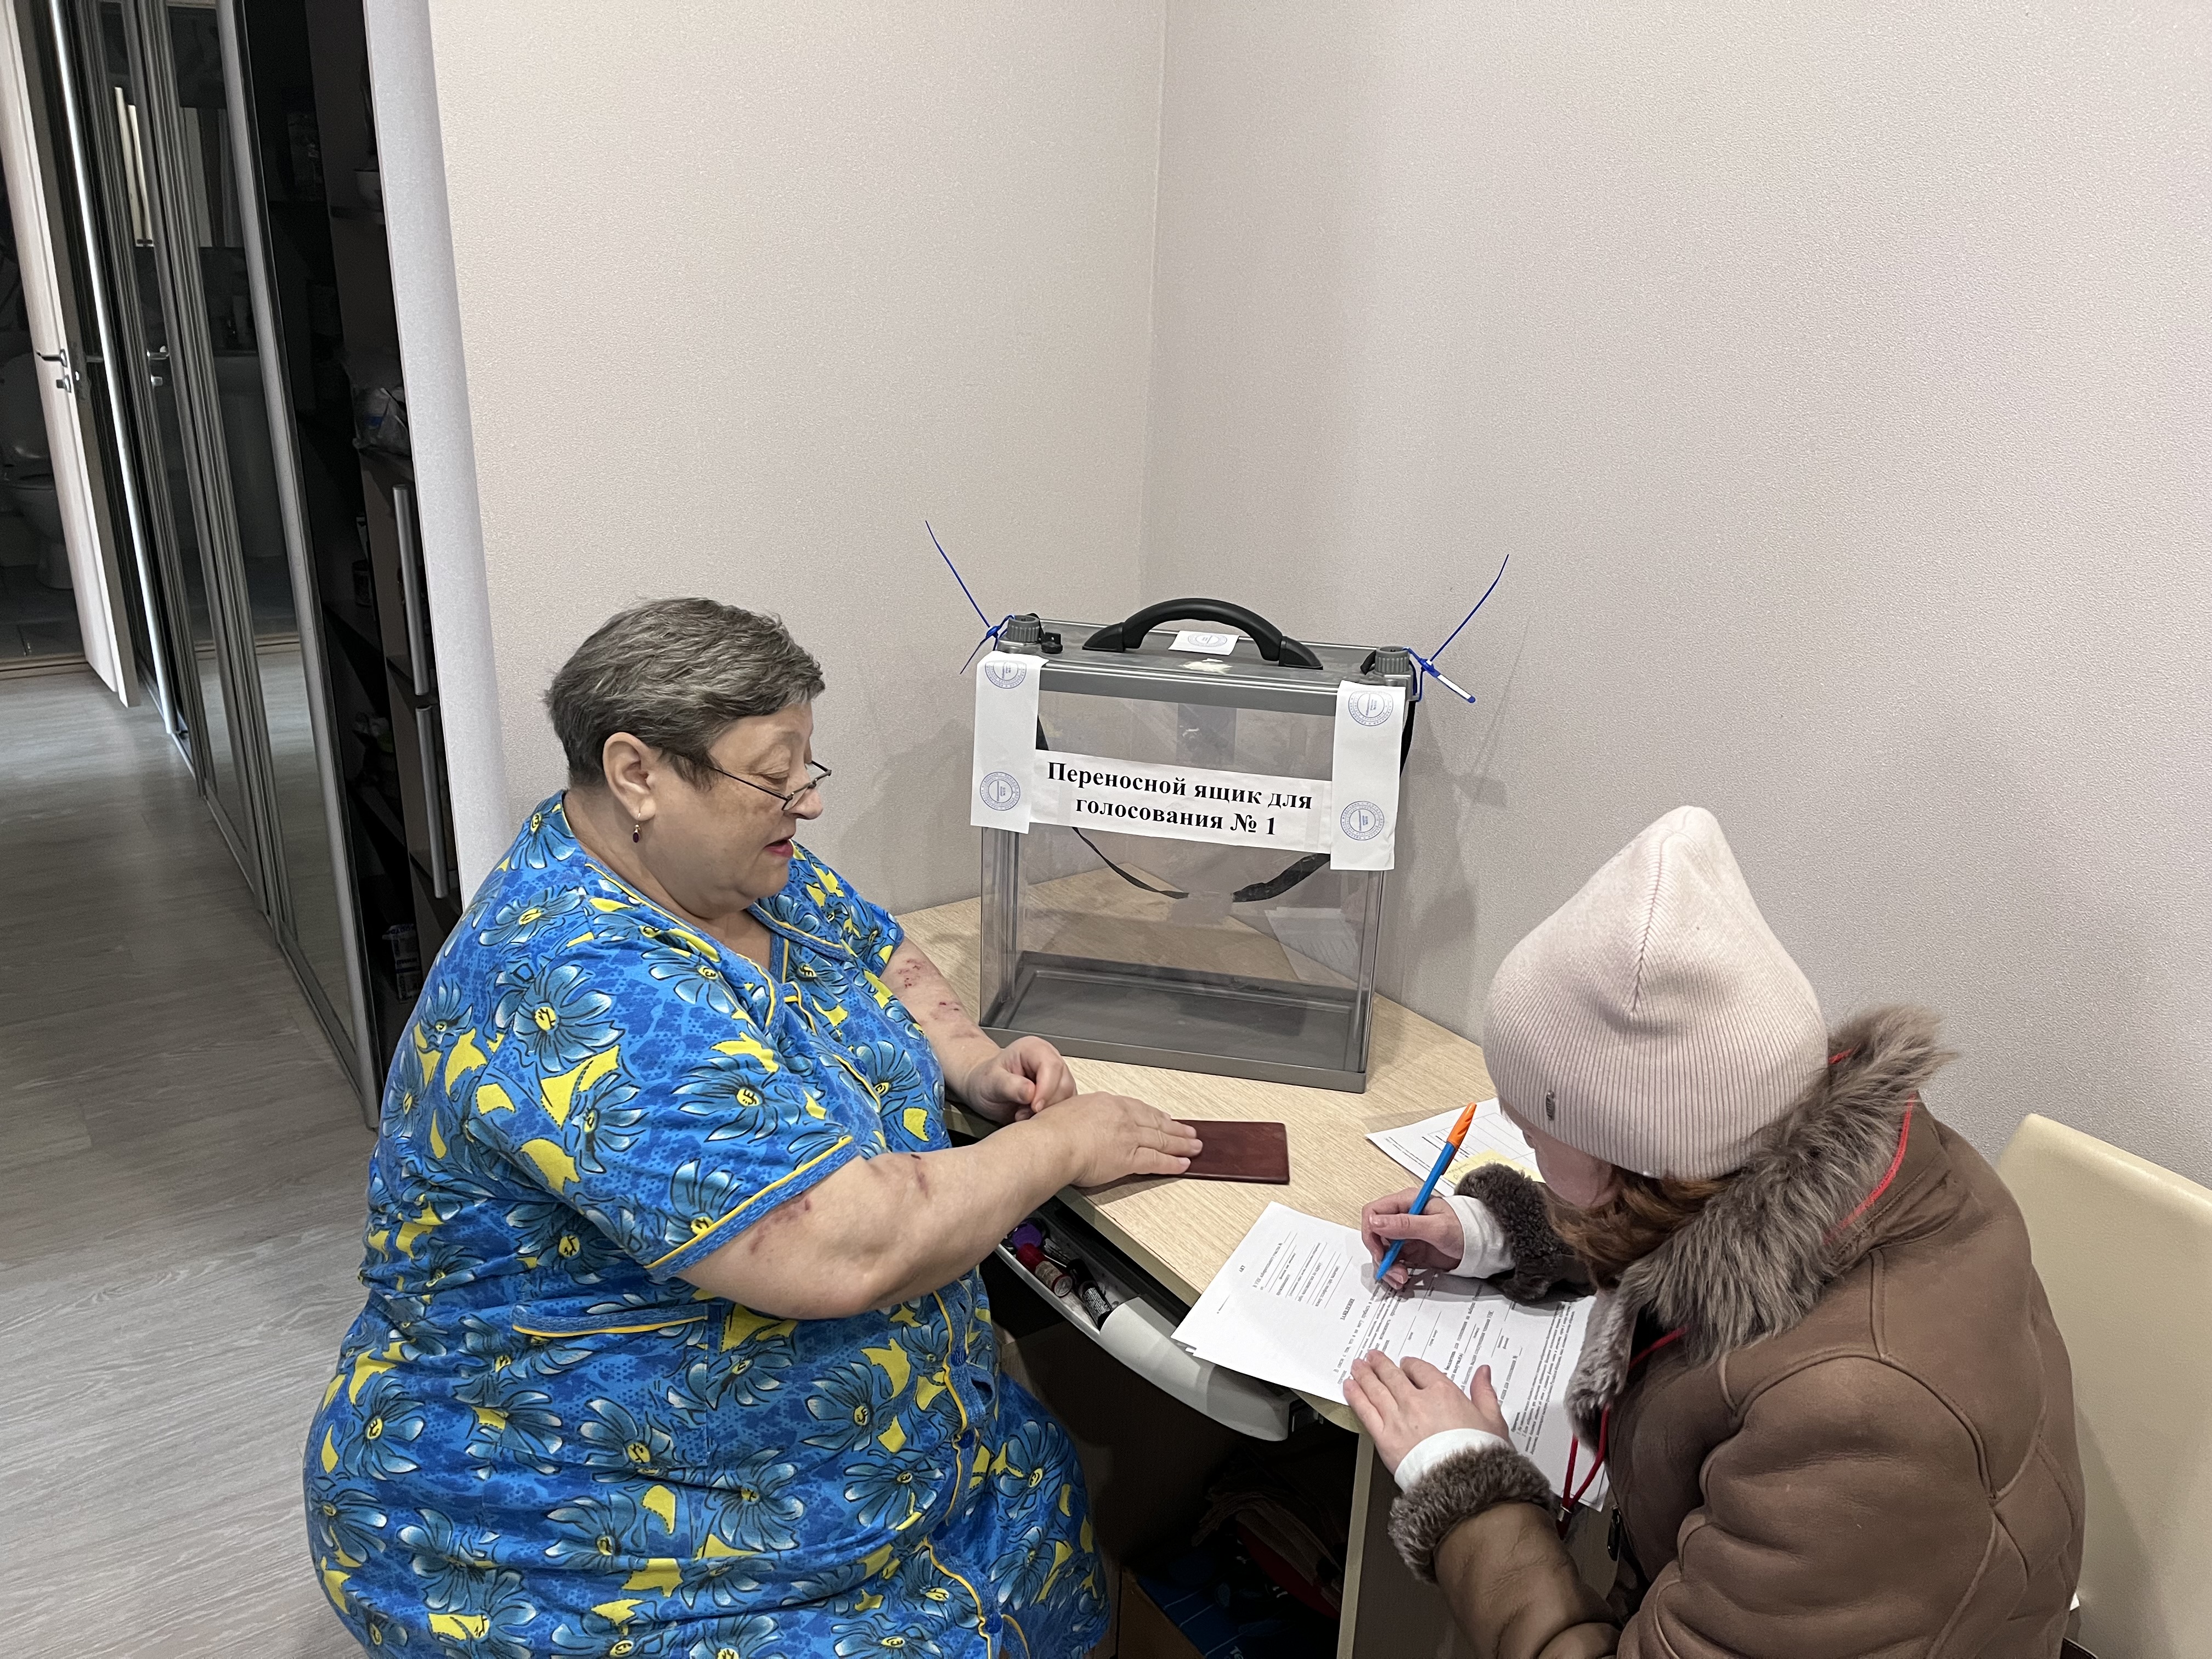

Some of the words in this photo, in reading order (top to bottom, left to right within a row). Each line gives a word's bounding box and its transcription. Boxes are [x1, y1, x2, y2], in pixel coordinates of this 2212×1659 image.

[1047, 761, 1186, 796] Переносной
[1194, 785, 1262, 805] ящик
[1268, 792, 1312, 809] для
[1076, 798, 1223, 830] голосования
[1230, 813, 1257, 833] №
[1266, 817, 1276, 836] 1
